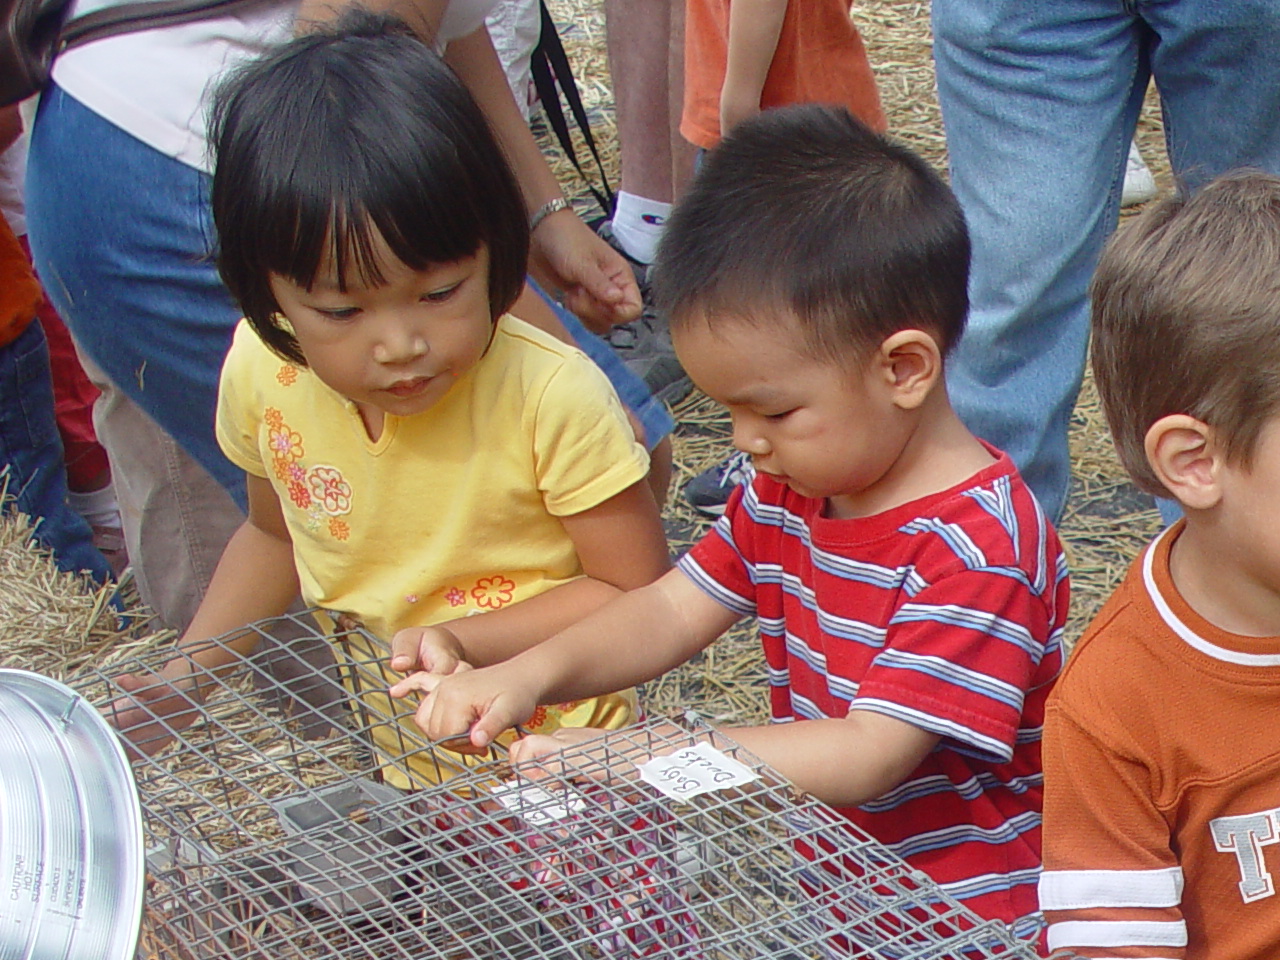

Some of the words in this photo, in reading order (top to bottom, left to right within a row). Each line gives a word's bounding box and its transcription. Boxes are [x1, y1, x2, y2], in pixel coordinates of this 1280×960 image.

[659, 766, 701, 793] Baby
[678, 751, 736, 783] Ducks
[23, 871, 33, 891] HOT
